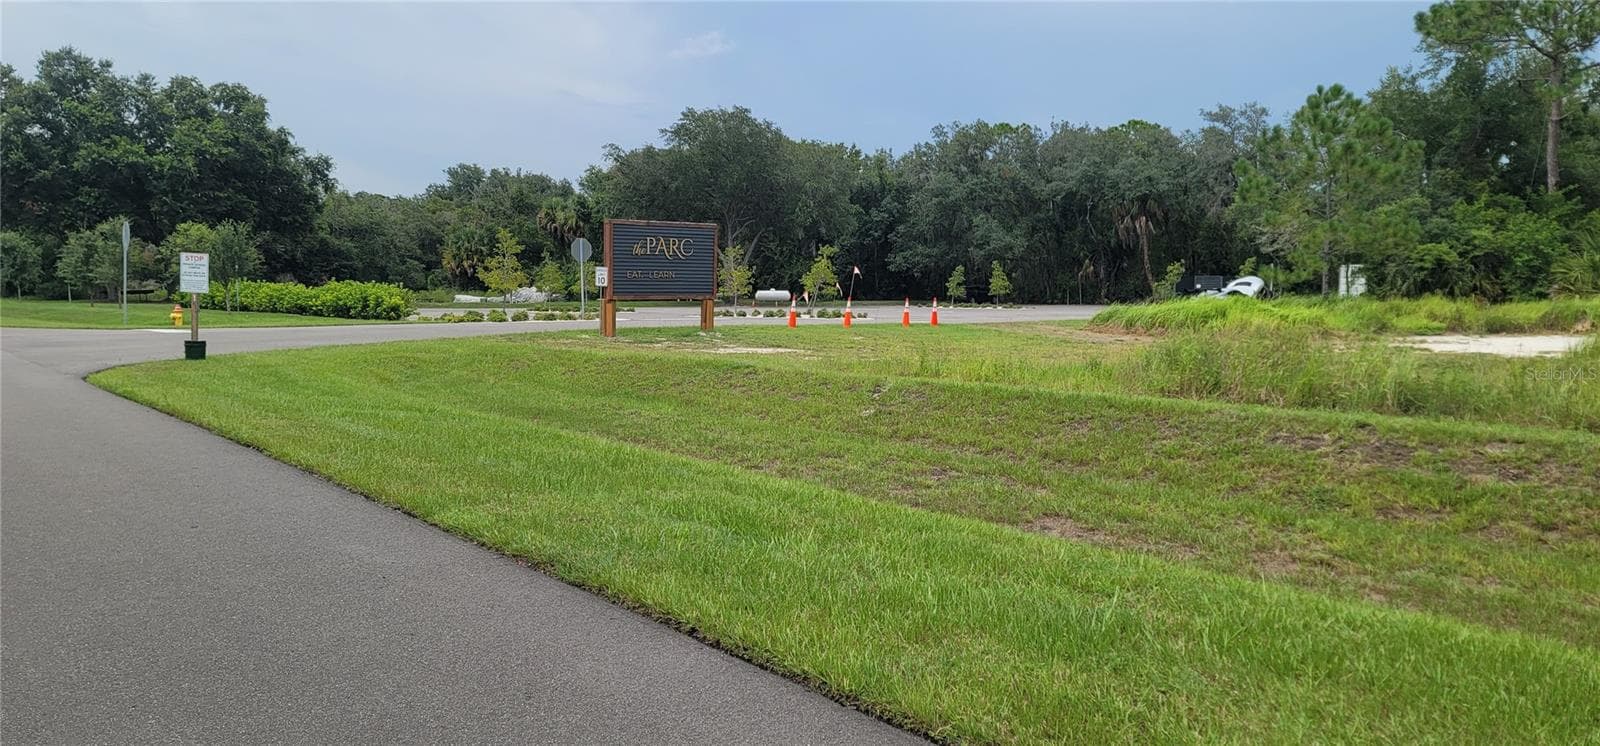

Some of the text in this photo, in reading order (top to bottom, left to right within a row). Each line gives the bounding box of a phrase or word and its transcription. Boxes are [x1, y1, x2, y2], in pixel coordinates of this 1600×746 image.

[632, 236, 694, 260] the PARC
[649, 270, 676, 280] LEARN
[598, 277, 605, 285] 10
